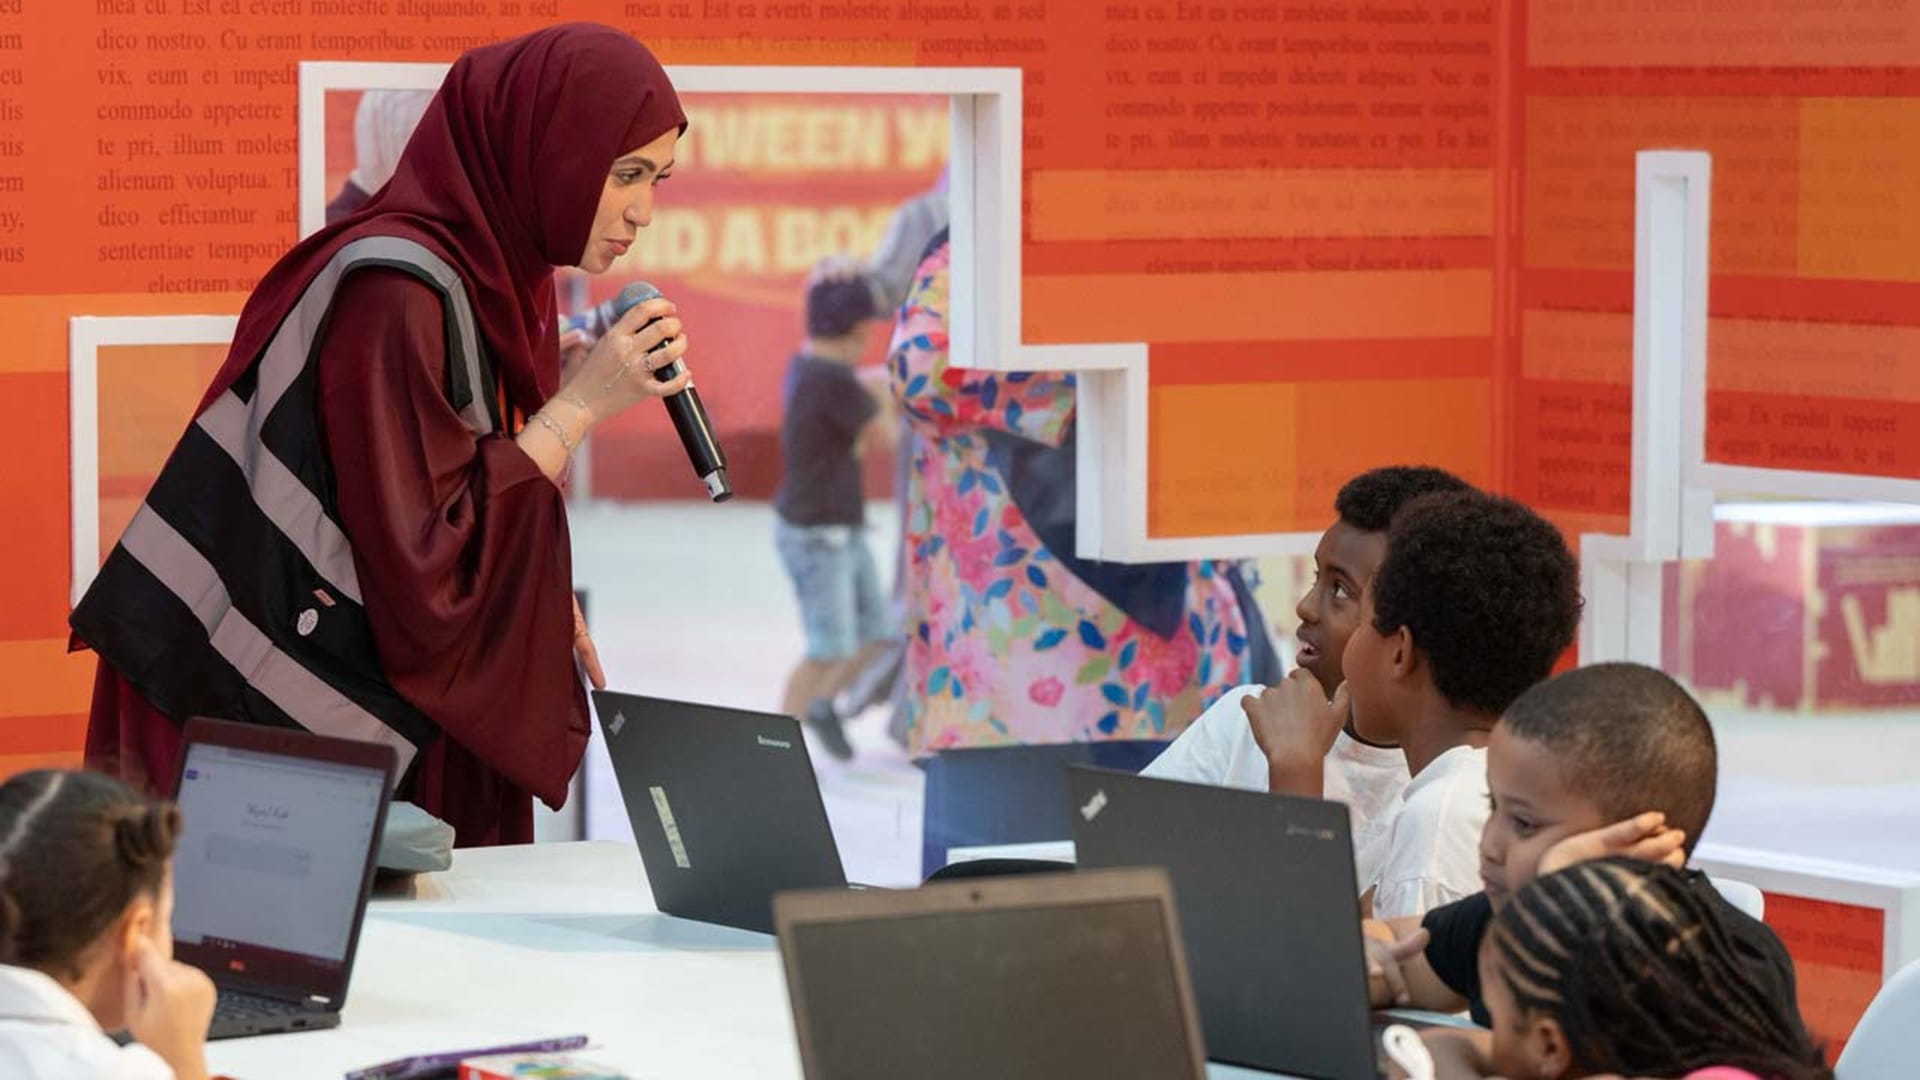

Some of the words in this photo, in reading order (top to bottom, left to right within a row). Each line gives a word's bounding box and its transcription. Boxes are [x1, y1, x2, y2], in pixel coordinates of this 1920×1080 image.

[96, 27, 138, 50] dico
[219, 28, 248, 50] Cu
[256, 32, 302, 50] erant
[310, 29, 414, 56] temporibus
[97, 99, 193, 121] commodo
[202, 103, 283, 126] appetere
[97, 136, 115, 156] te
[173, 132, 223, 156] illum
[97, 168, 174, 192] alienum
[97, 204, 140, 227] dico
[158, 203, 256, 226] efficiantur
[716, 204, 767, 275] A
[98, 241, 194, 263] sententiae
[147, 273, 229, 294] electram
